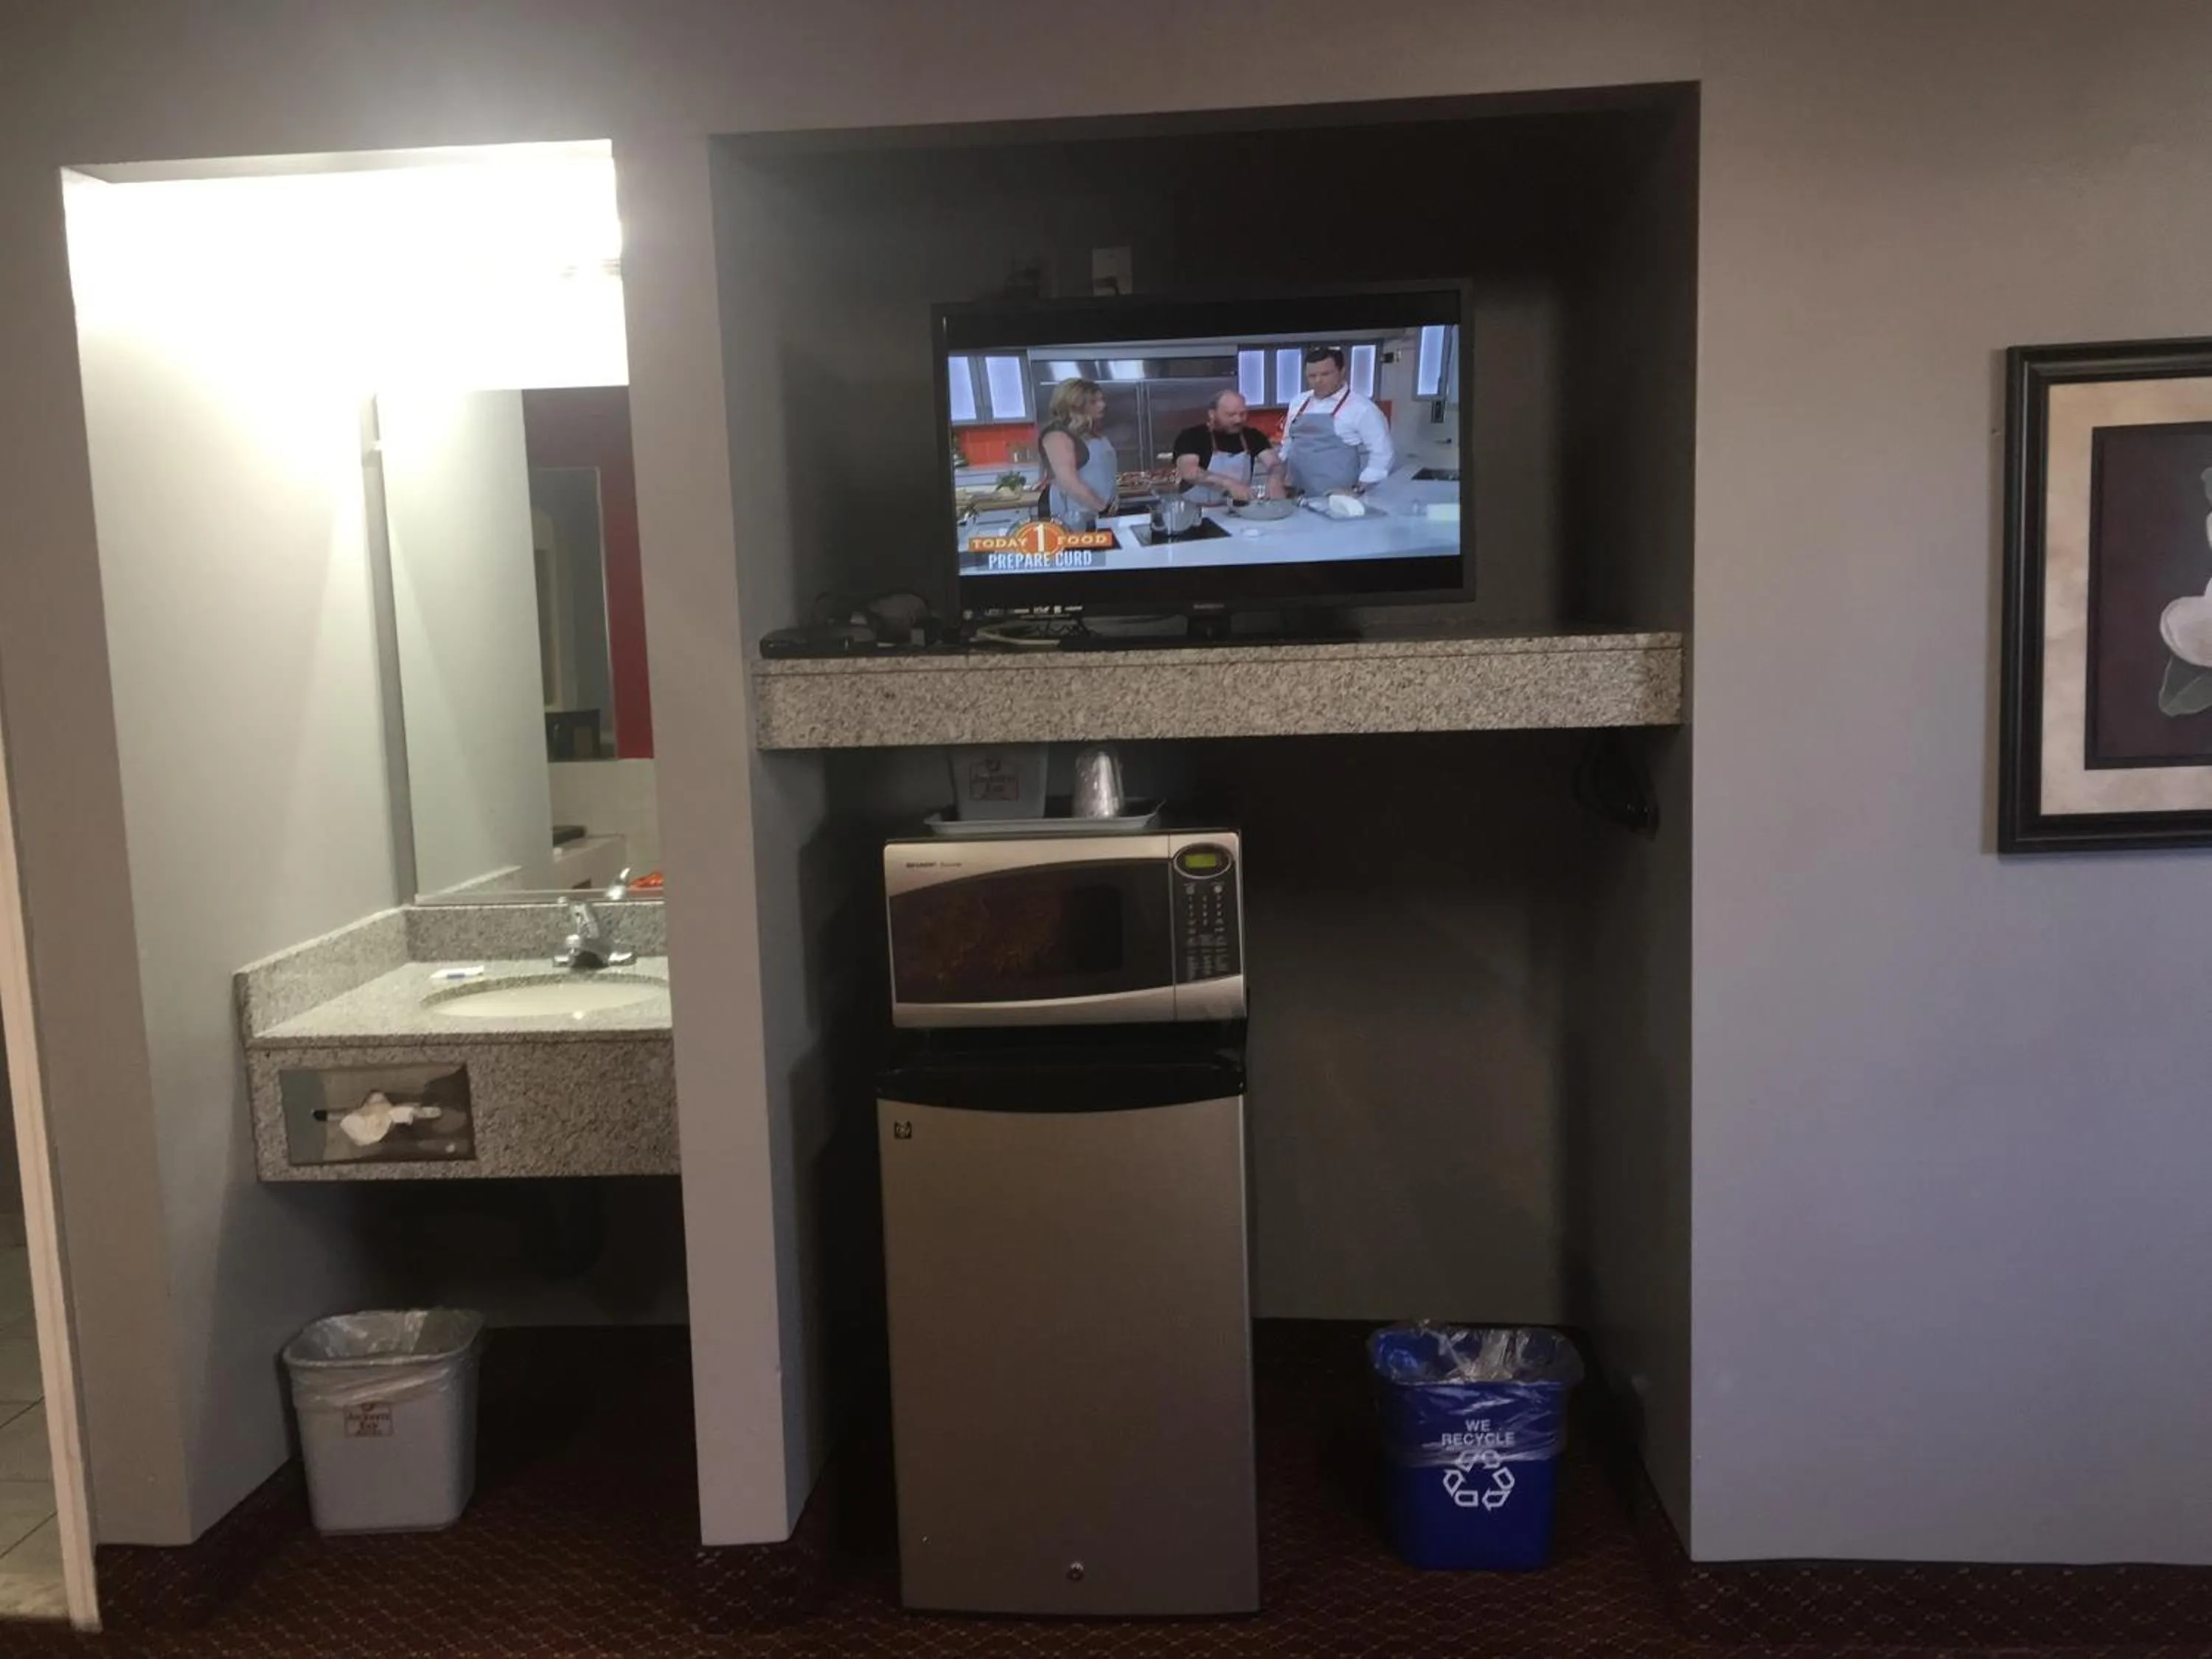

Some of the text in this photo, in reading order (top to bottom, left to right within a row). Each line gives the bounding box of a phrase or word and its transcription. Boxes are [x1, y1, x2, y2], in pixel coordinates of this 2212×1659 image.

[973, 522, 1107, 552] TODAY 1 FOOD
[988, 549, 1093, 569] PREPARE CURD
[1464, 1419, 1490, 1432] WE
[1441, 1432, 1514, 1447] RECYCLE
